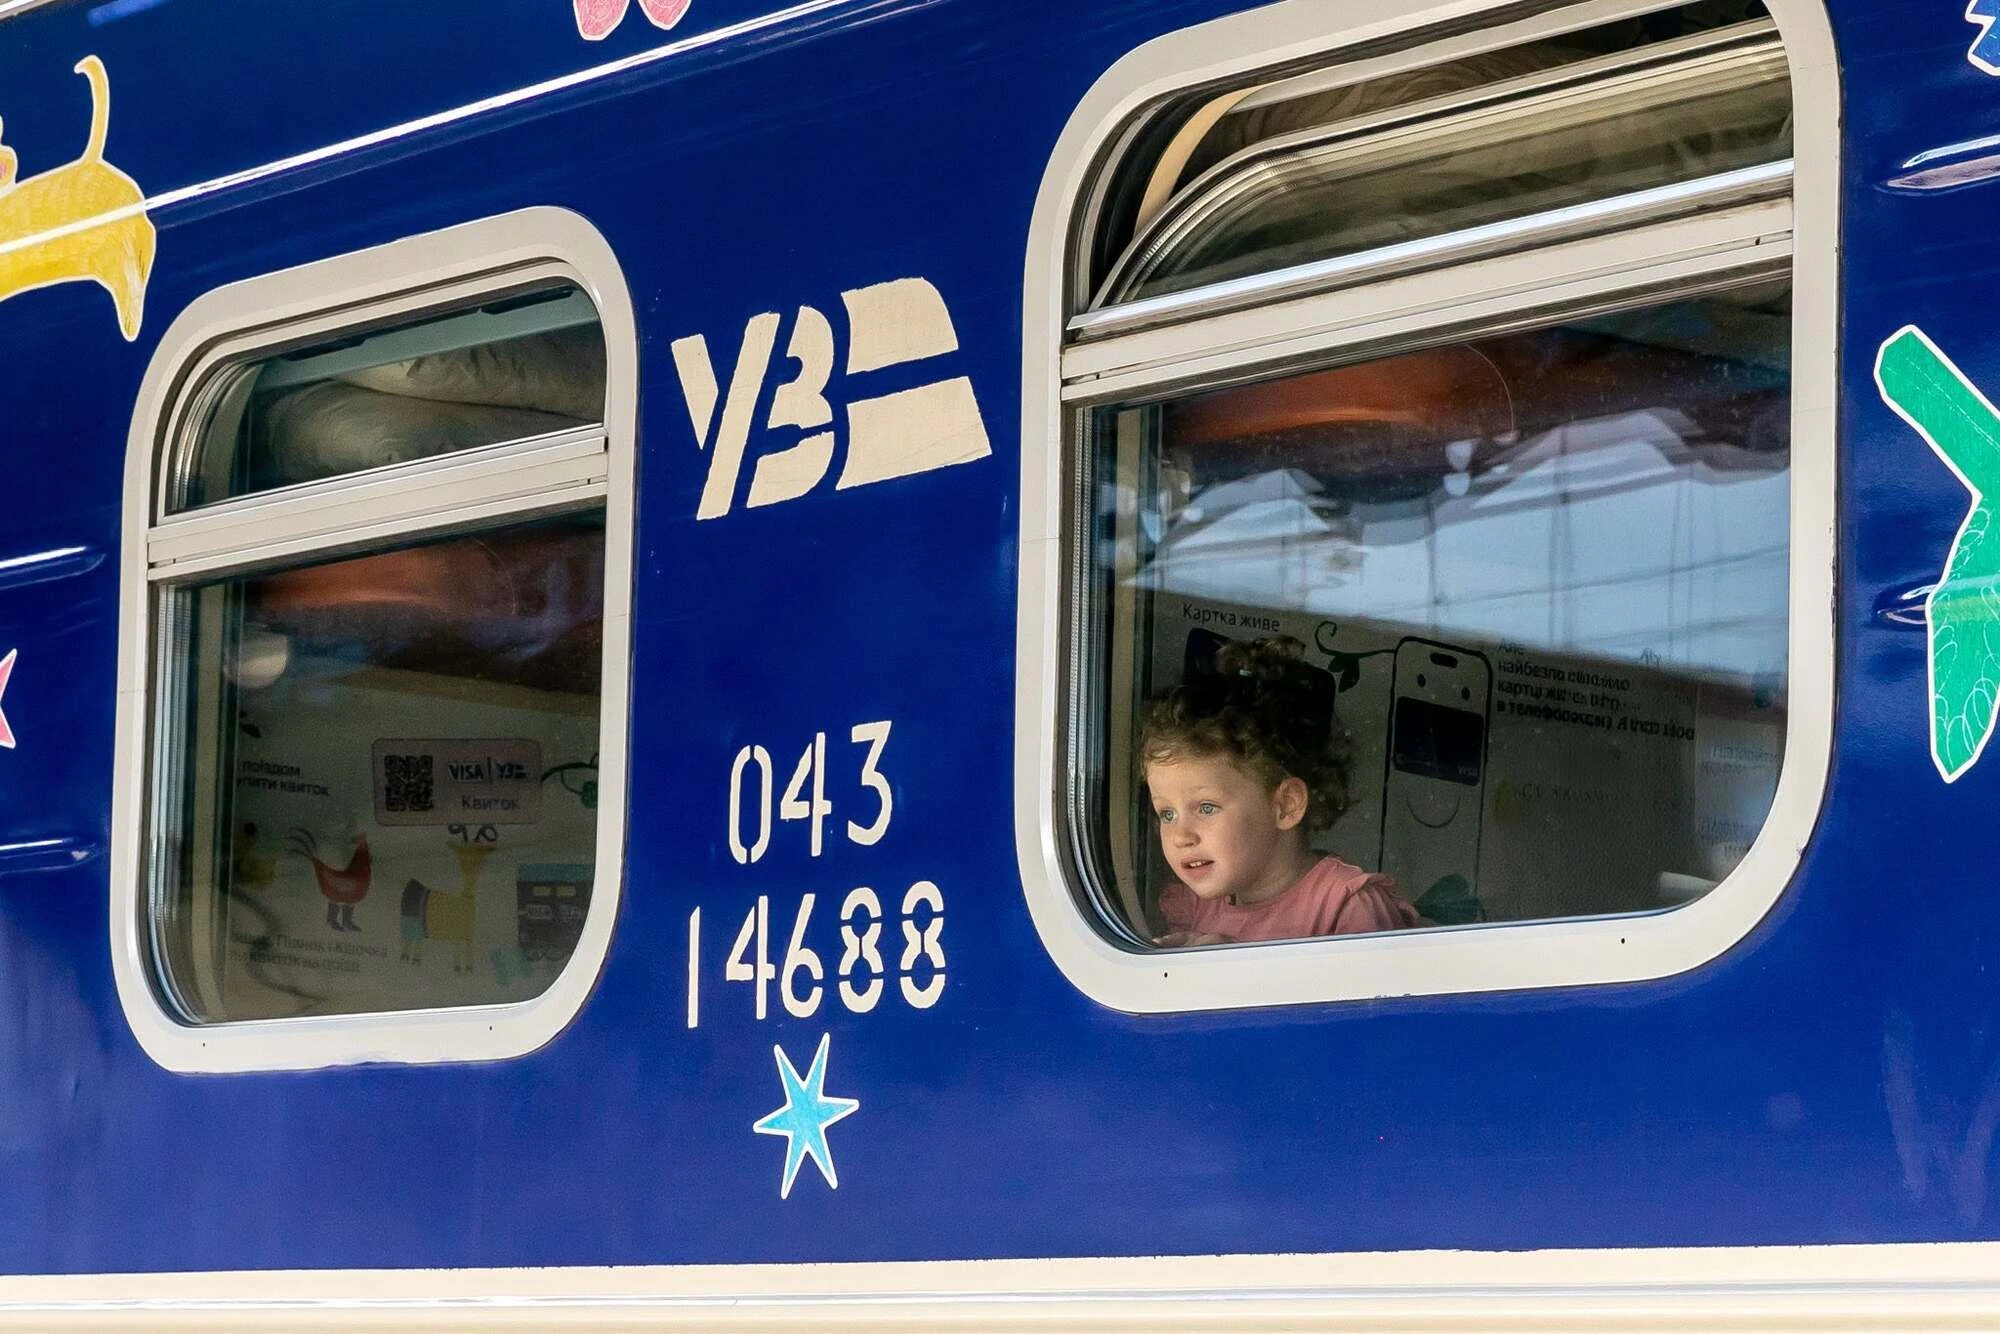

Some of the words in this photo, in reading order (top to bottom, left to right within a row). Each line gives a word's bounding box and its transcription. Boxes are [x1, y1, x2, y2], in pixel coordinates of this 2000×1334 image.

[1182, 603, 1236, 625] Картка
[1240, 616, 1281, 632] живе
[449, 763, 484, 780] VISA
[461, 795, 521, 810] Квиток
[729, 721, 892, 864] 043
[688, 881, 945, 1028] 14688
